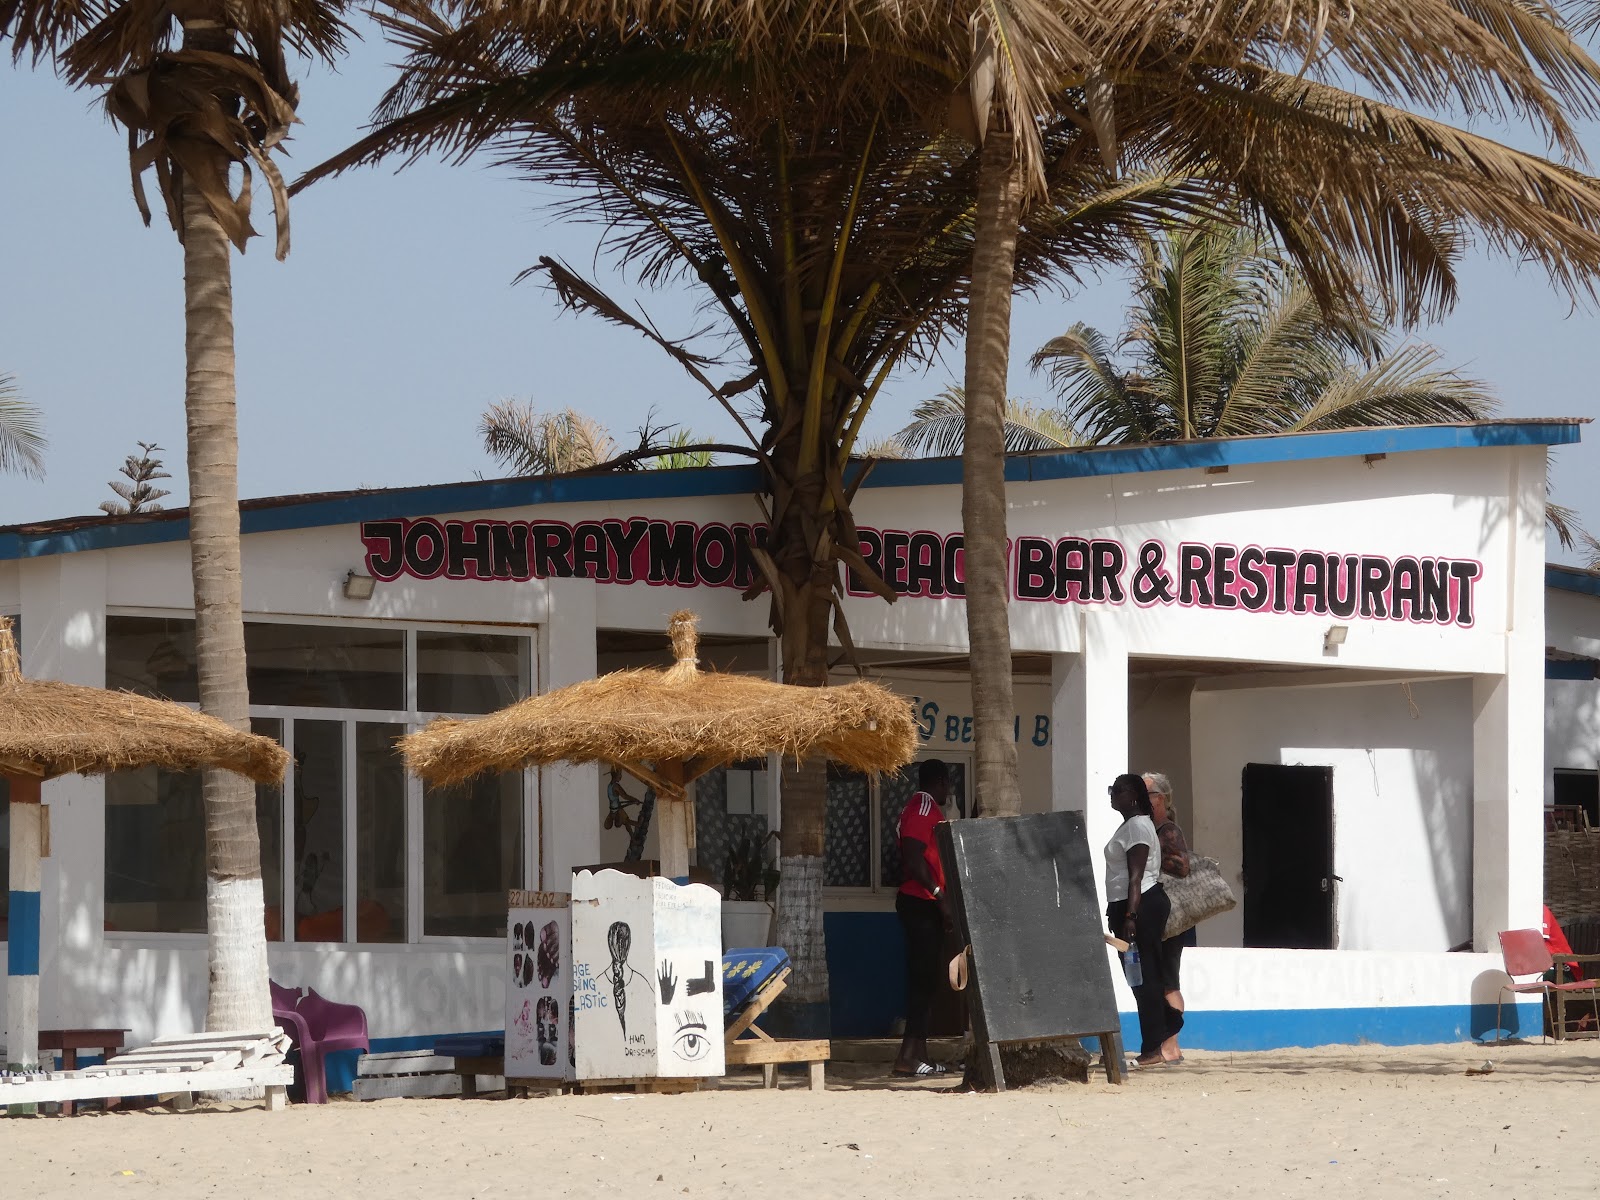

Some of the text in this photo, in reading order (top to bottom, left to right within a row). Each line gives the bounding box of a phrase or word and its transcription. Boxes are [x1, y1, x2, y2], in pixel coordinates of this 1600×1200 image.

[361, 517, 1484, 629] JOHNRAYMON BEAC BAR & RESTAURANT
